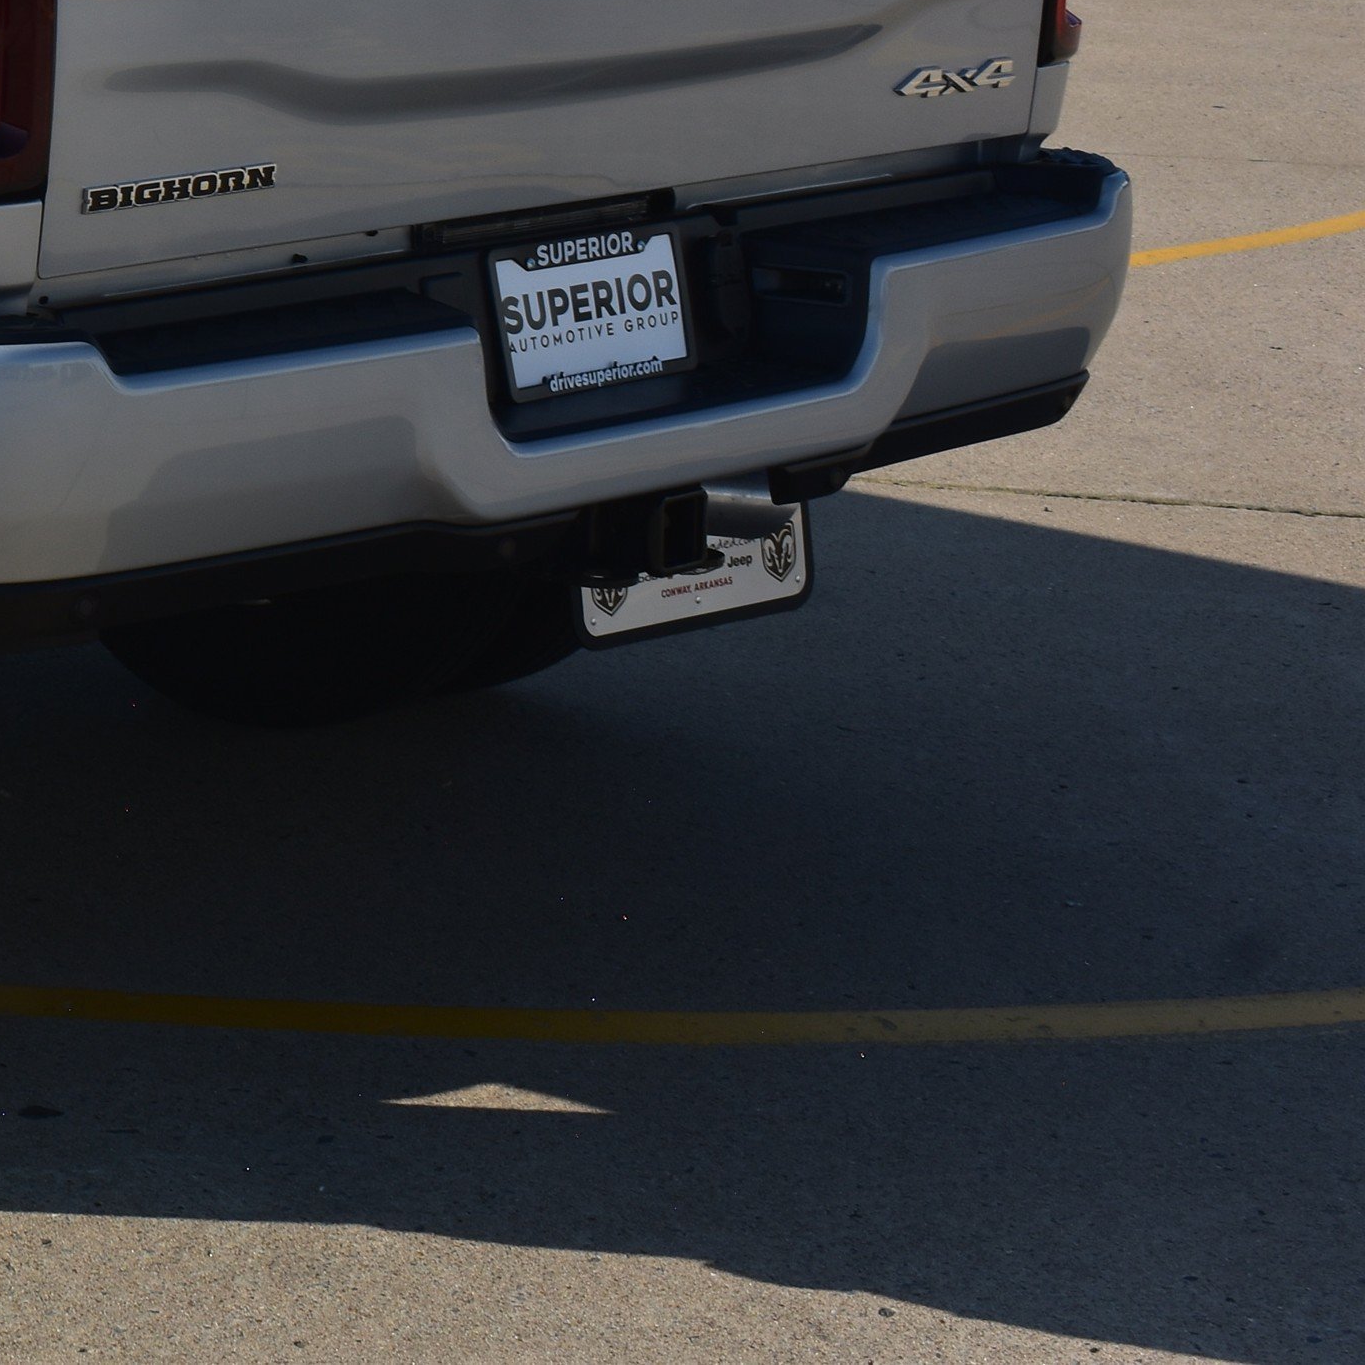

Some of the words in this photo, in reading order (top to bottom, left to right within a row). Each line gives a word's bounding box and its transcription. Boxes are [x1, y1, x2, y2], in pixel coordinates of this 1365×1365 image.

[81, 162, 277, 215] BIGHORN
[536, 231, 634, 267] SUPERIOR
[501, 269, 677, 335] SUPERIOR
[510, 321, 615, 354] AUTOMOTIVE
[624, 310, 679, 332] GROUP
[549, 358, 663, 393] drivesuperior.com
[727, 555, 753, 568] Jeep
[694, 576, 733, 592] ARKANSAS
